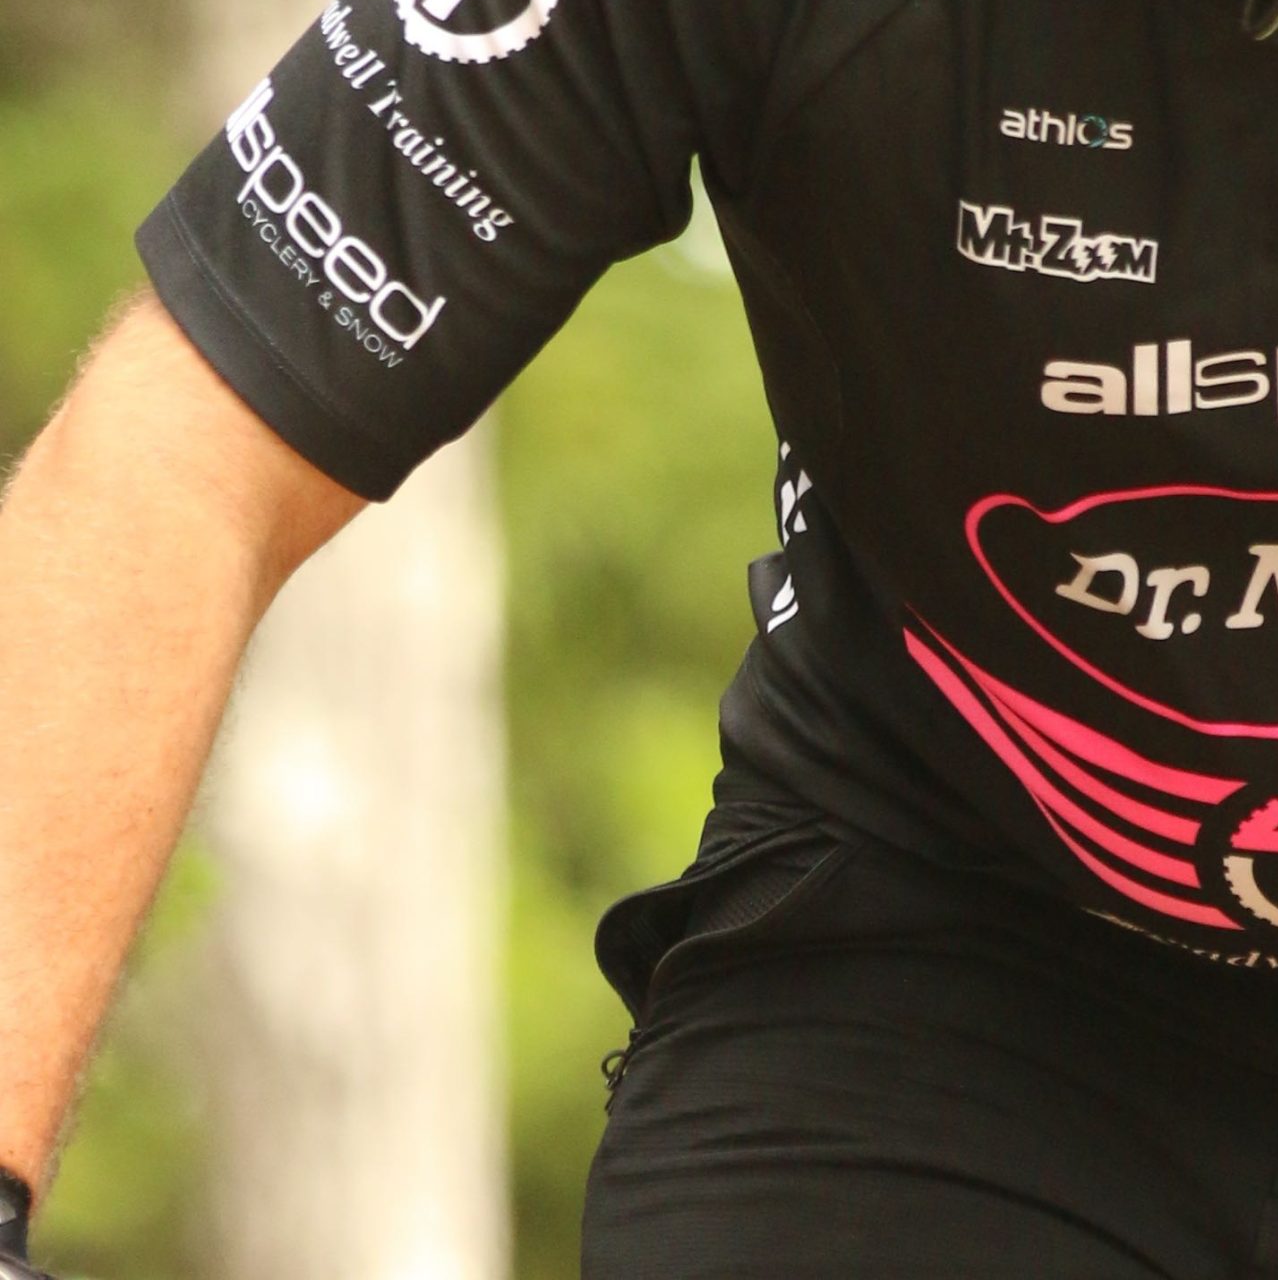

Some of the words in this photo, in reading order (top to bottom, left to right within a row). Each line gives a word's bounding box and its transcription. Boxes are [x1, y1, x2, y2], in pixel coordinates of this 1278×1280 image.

[367, 80, 514, 242] Training
[1000, 108, 1133, 150] athlos
[225, 78, 446, 350] llspeed
[241, 199, 320, 288] CYCLERY
[317, 291, 334, 311] &
[333, 306, 404, 369] SNOW
[1055, 551, 1210, 640] Dr.
